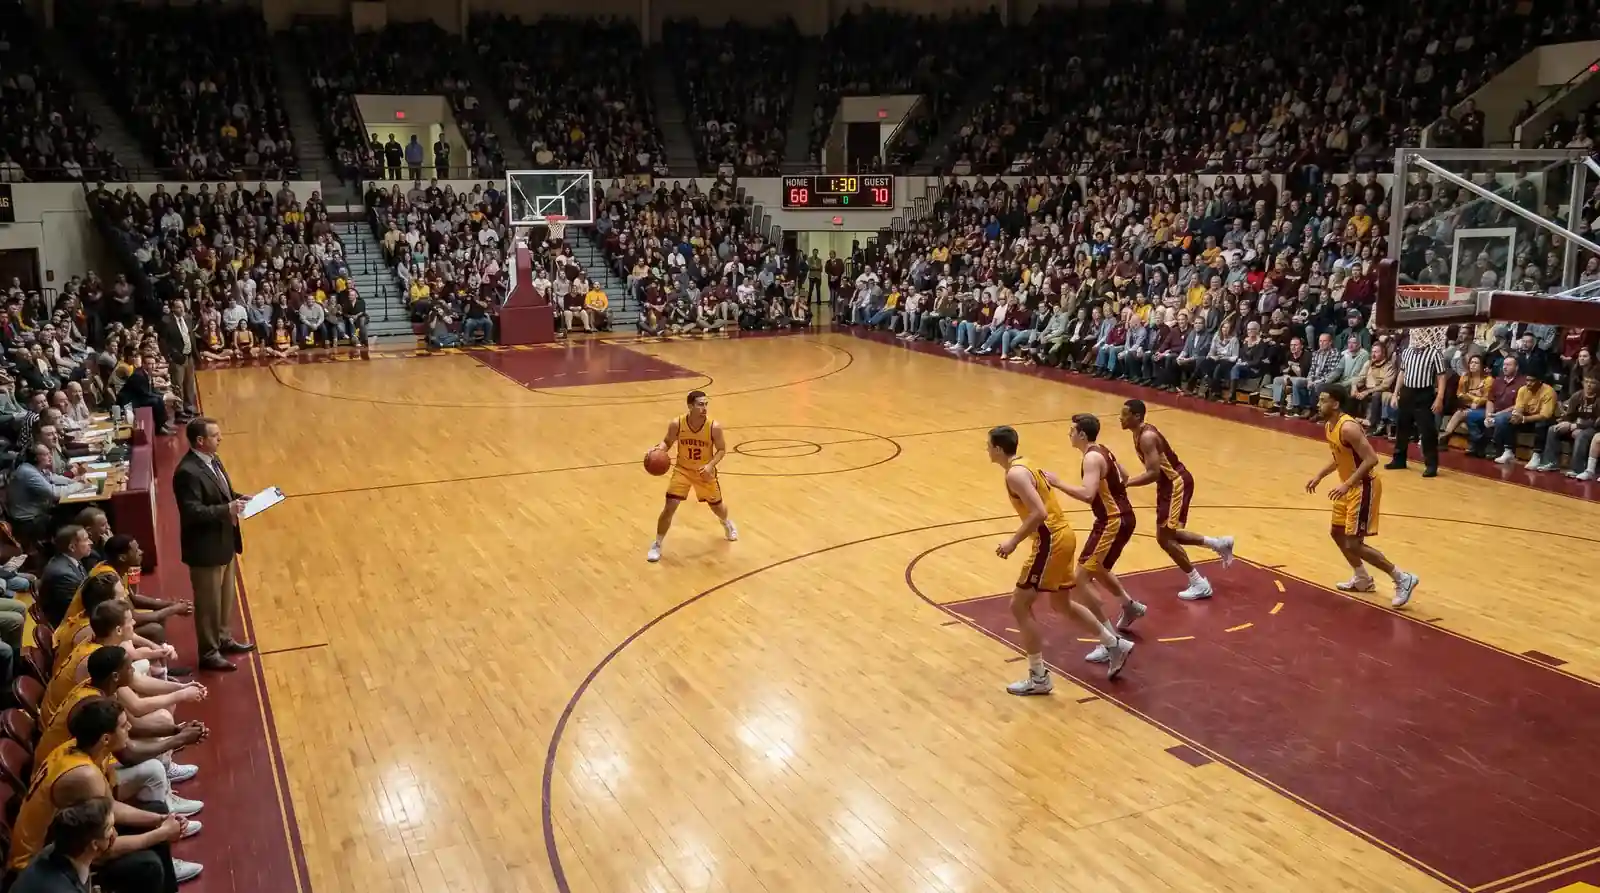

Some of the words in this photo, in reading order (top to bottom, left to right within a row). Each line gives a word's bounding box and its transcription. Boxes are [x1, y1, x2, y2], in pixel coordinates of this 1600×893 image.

[786, 178, 808, 187] HOME
[831, 178, 856, 192] 1:30
[864, 177, 889, 186] GUEST
[791, 188, 808, 203] 68
[871, 188, 889, 203] 70
[688, 448, 701, 460] 12
